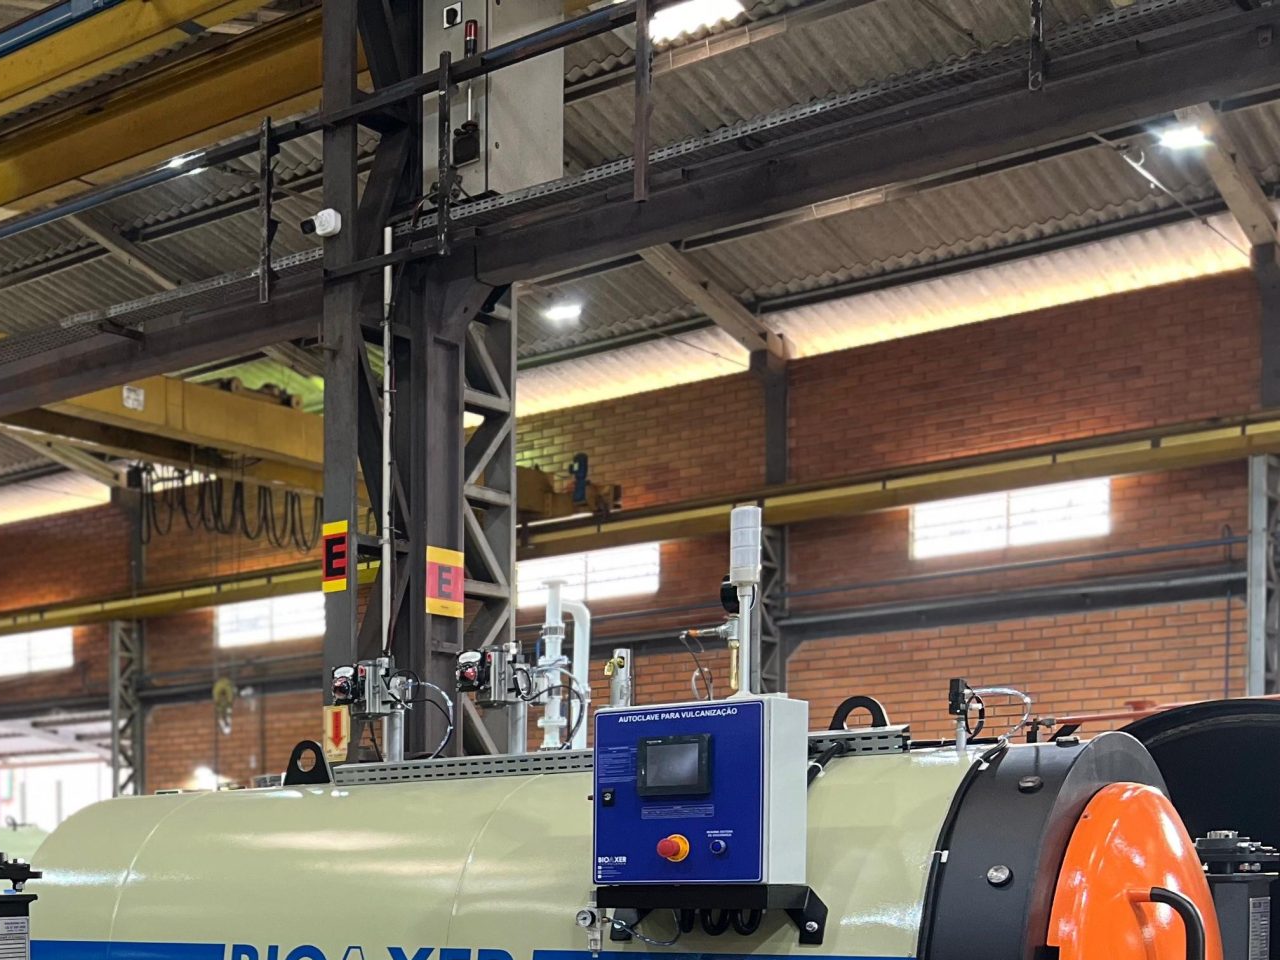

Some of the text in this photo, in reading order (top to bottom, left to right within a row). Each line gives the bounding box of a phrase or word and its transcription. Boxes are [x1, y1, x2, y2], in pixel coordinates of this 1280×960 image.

[324, 535, 346, 577] E
[437, 565, 453, 599] E
[618, 707, 738, 723] AUTOCLAVE PARA VULCANIZAÇÃO
